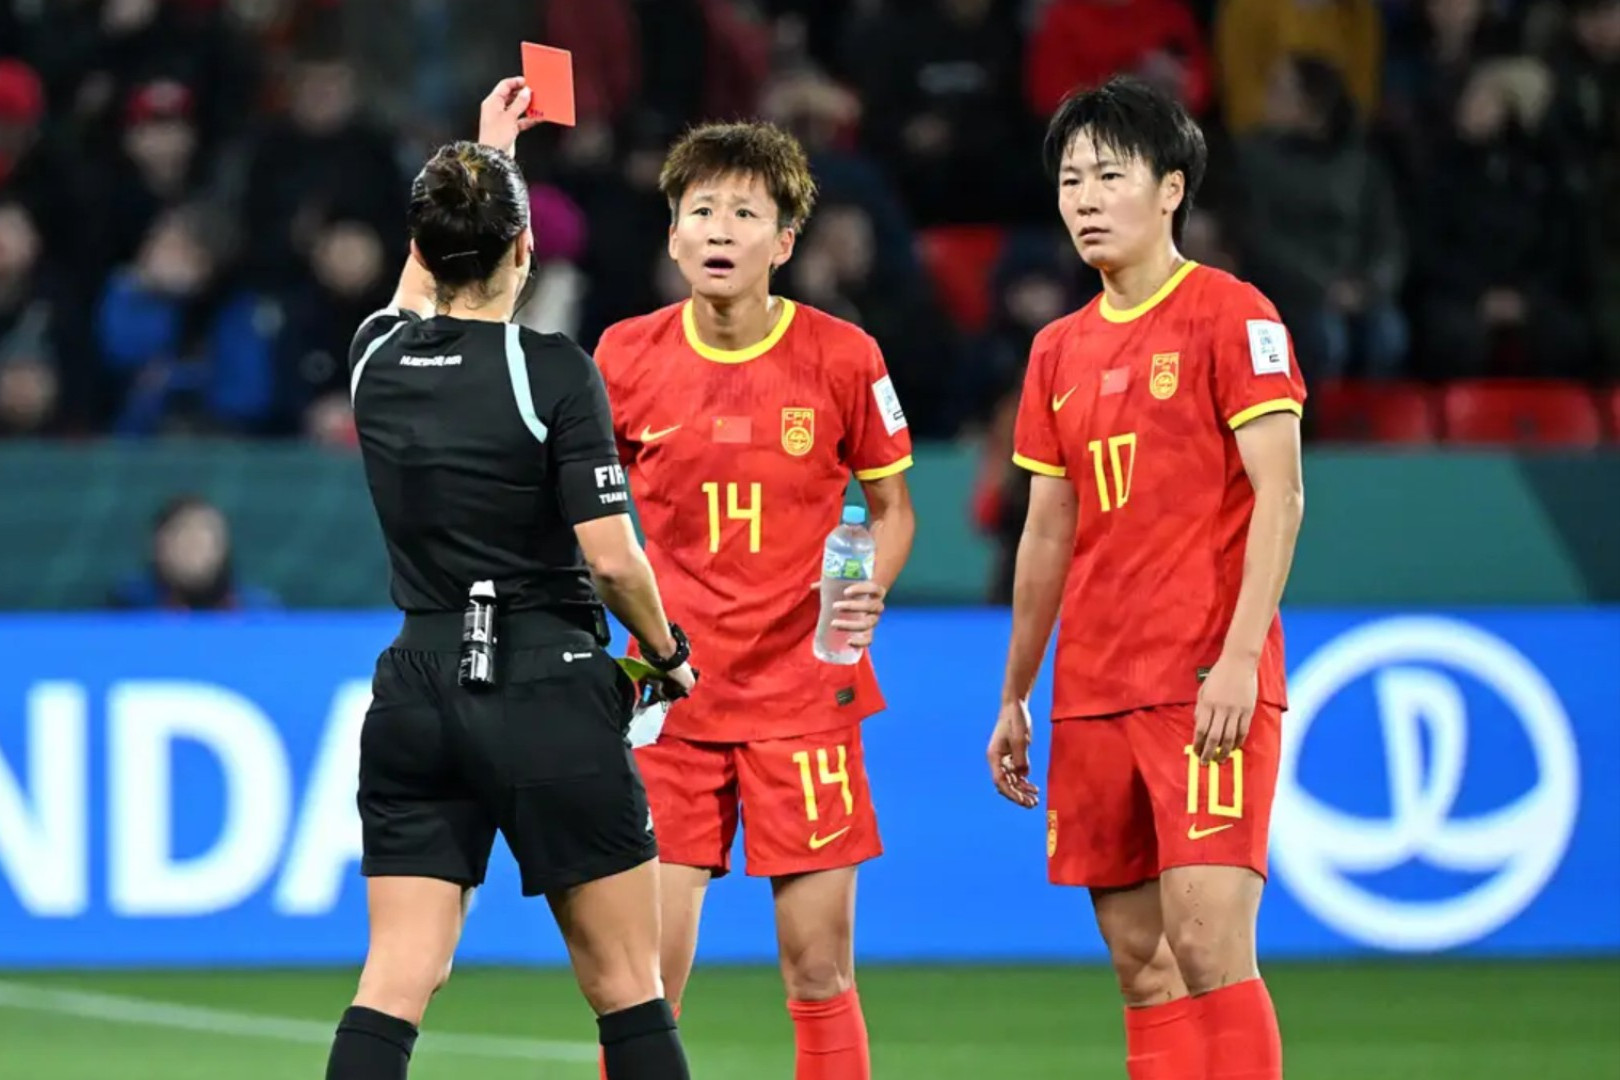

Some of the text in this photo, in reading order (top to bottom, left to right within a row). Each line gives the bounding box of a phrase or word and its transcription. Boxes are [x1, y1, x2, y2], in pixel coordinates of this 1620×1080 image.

[1088, 432, 1136, 512] 10
[701, 482, 762, 553] 14
[792, 745, 853, 821] 14
[1184, 745, 1243, 818] 10
